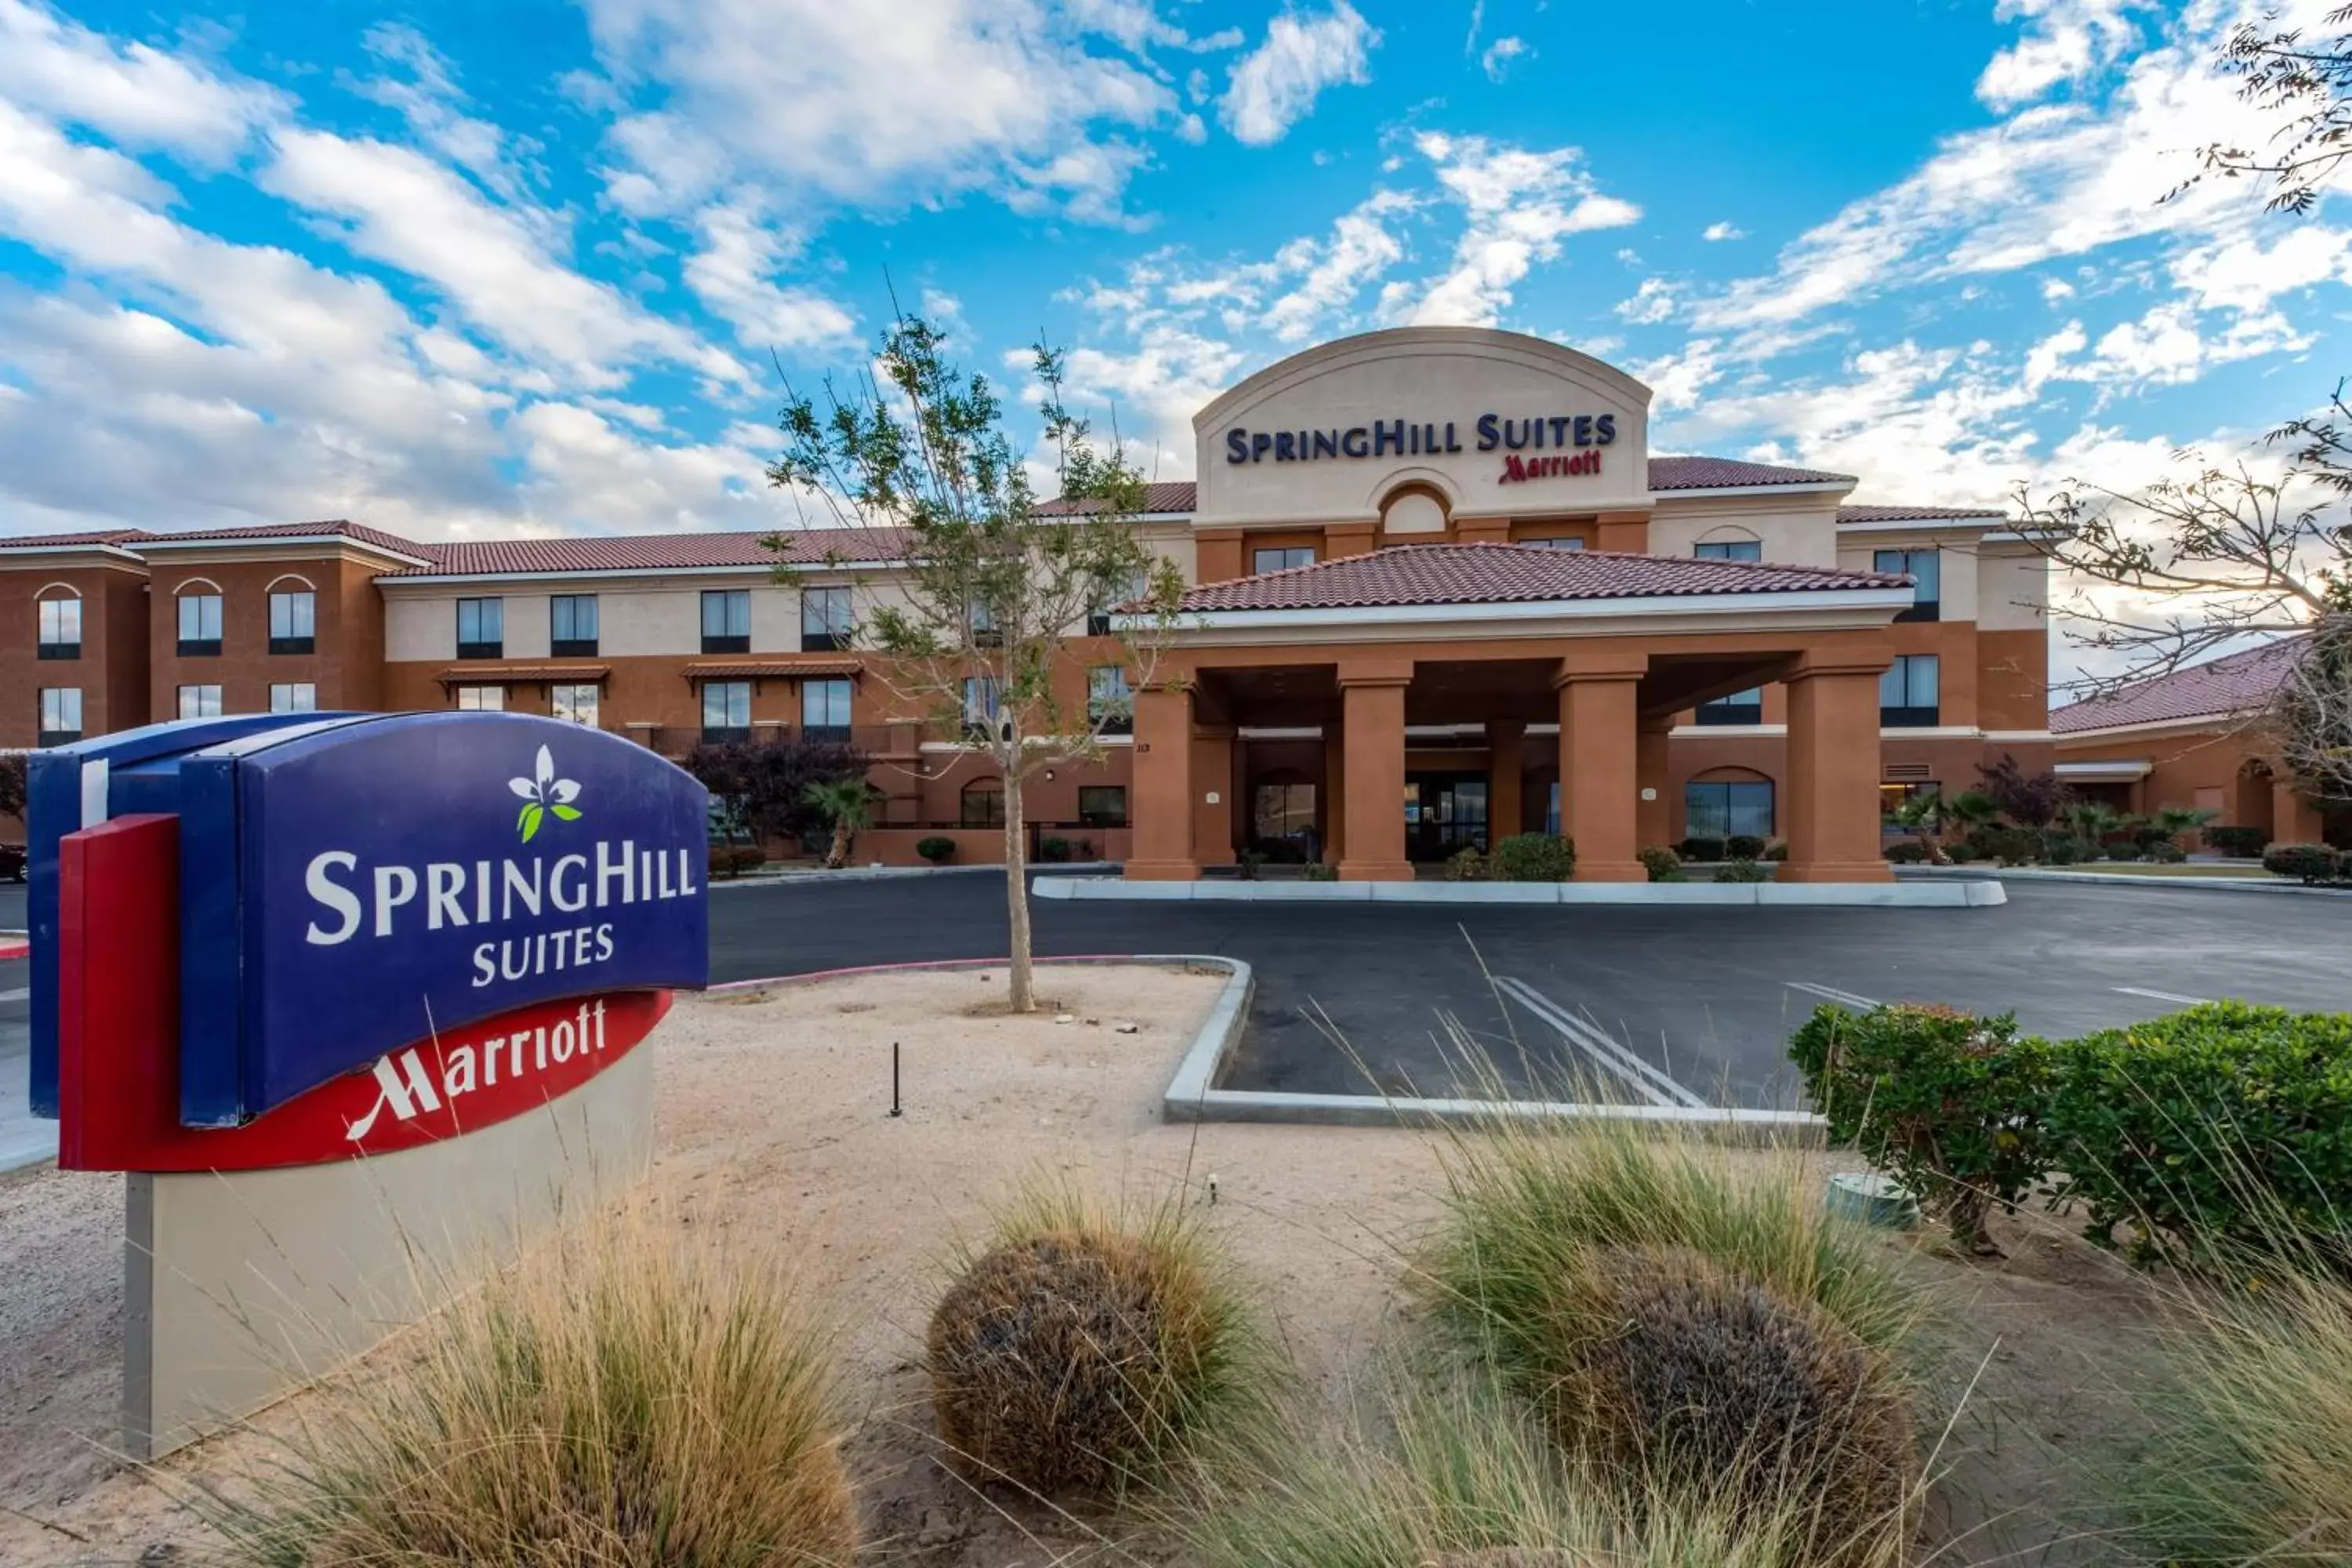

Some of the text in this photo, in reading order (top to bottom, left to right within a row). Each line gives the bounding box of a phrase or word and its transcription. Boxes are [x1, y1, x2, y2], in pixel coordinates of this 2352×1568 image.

[1477, 413, 1617, 451] SUITES
[1498, 449, 1602, 485] Marriott
[472, 923, 614, 987] SUITES
[346, 998, 606, 1141] Marriott
